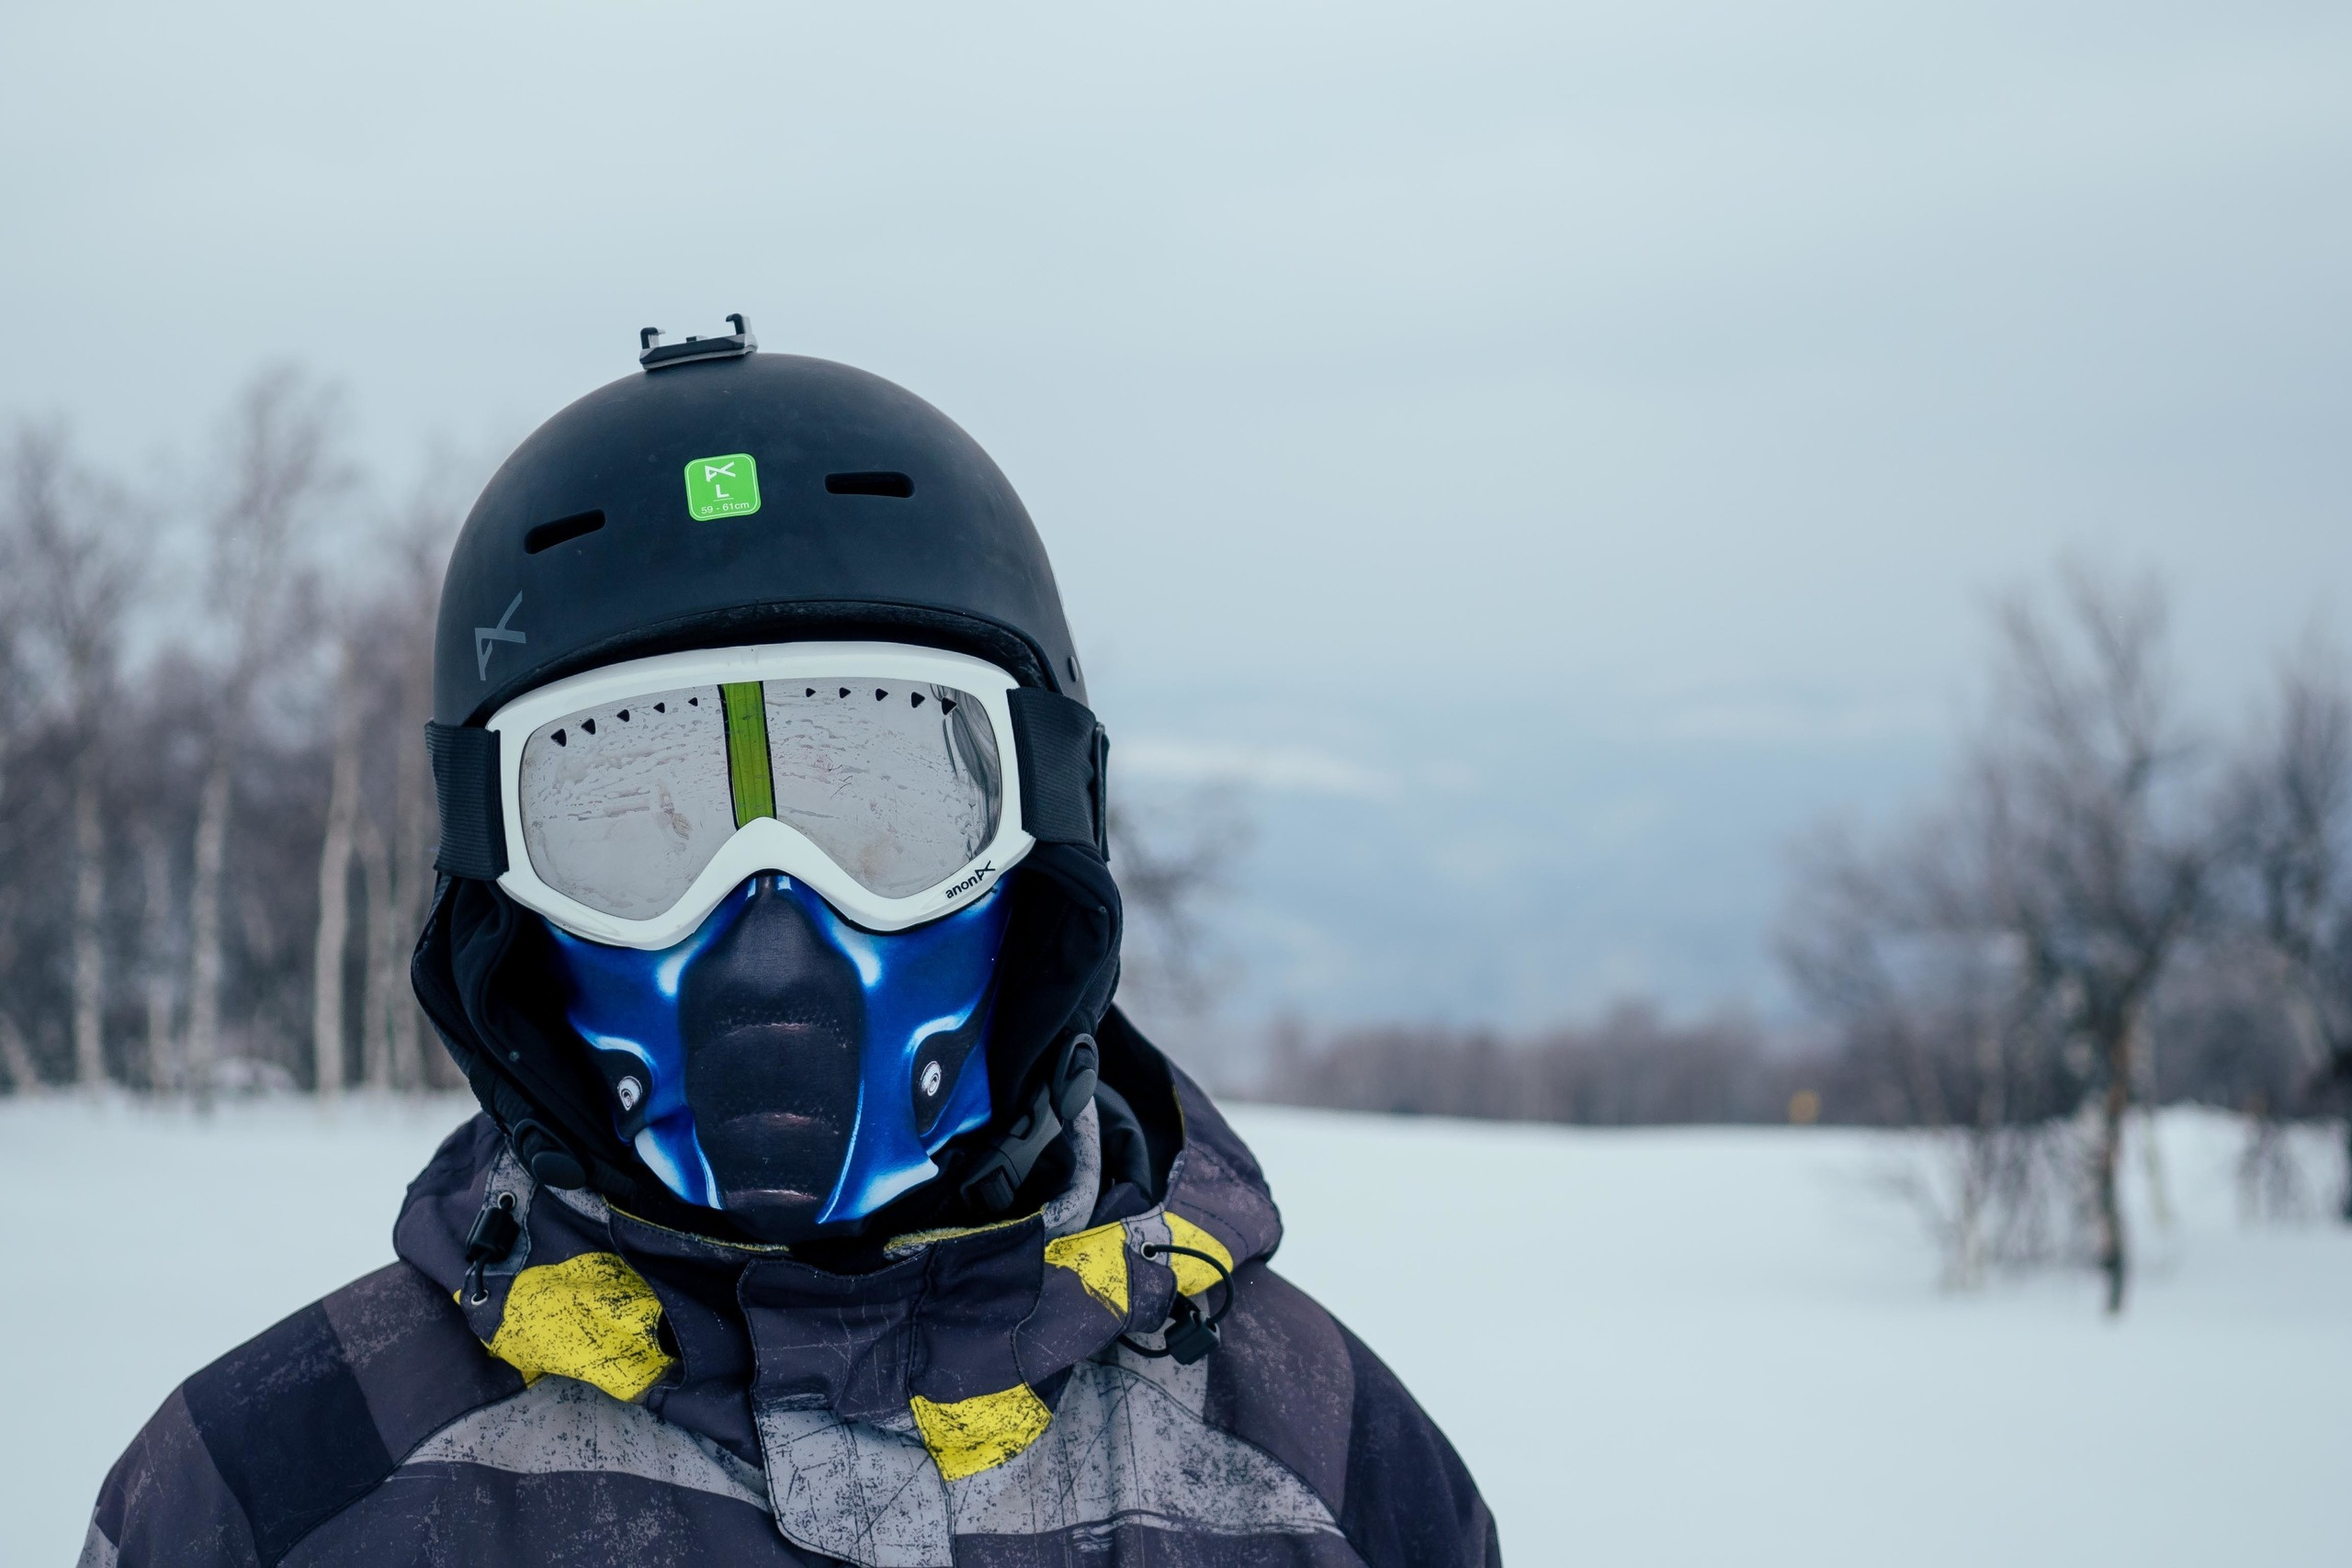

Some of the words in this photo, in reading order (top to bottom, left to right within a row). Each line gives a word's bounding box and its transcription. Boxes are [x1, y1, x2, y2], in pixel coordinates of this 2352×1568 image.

[716, 484, 729, 498] L
[701, 506, 713, 514] 59
[722, 502, 750, 511] 61cm
[945, 876, 978, 898] anon
